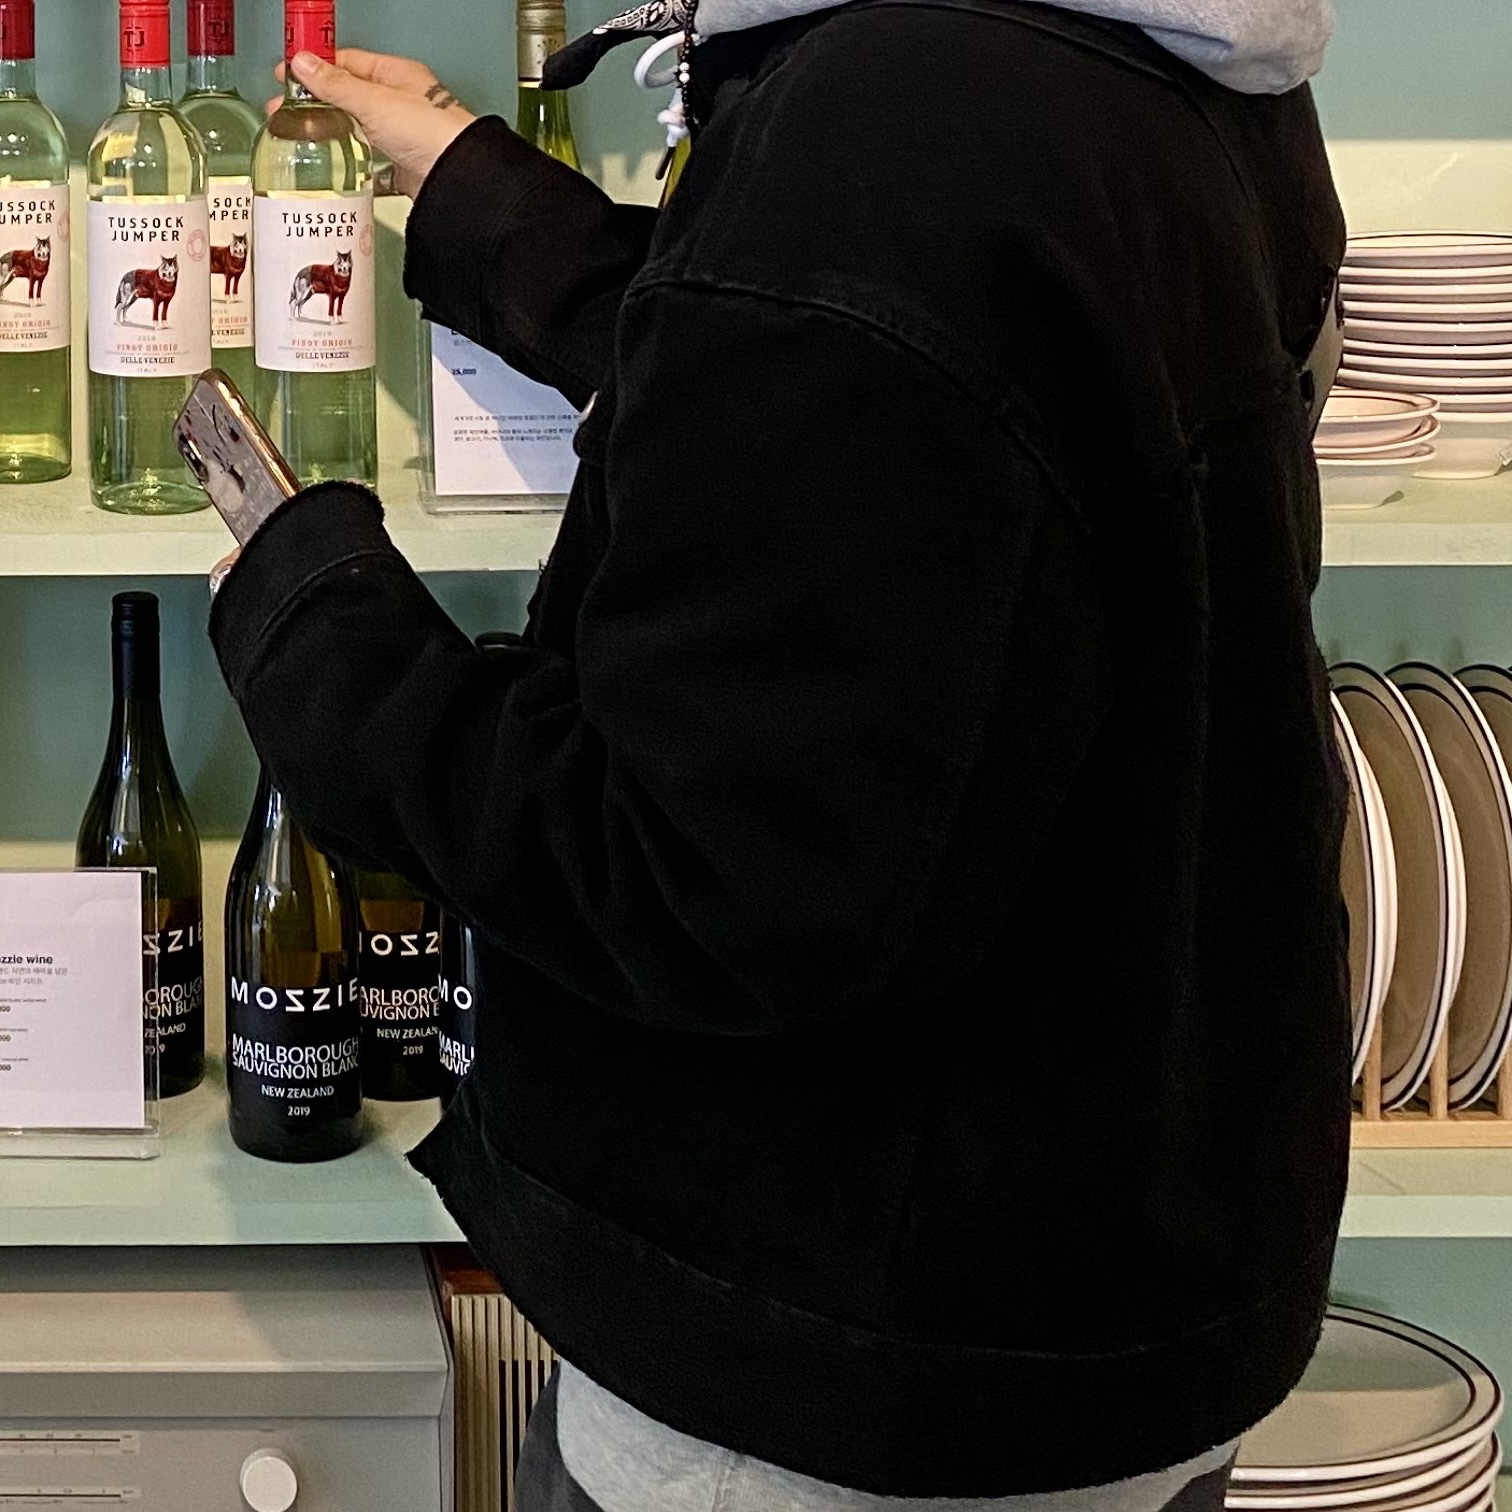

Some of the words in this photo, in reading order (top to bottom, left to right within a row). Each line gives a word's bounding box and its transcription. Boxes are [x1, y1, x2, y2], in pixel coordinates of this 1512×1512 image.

[124, 30, 145, 47] TJ
[108, 216, 184, 228] TUSSOCK
[283, 212, 358, 224] TUSSOCK
[112, 230, 180, 242] JUMPER
[286, 225, 354, 237] JUMPER
[27, 955, 53, 964] wine
[377, 1028, 400, 1039] NEW
[403, 1026, 438, 1038] ZEALAN
[232, 1033, 359, 1065] MARLBOROUGH
[403, 1046, 423, 1055] 2019
[232, 1051, 317, 1080] SAUVIGNON
[322, 1055, 359, 1078] BLANC
[262, 1085, 285, 1097] NEW
[287, 1086, 334, 1098] ZEALAND
[288, 1106, 310, 1116] 2019
